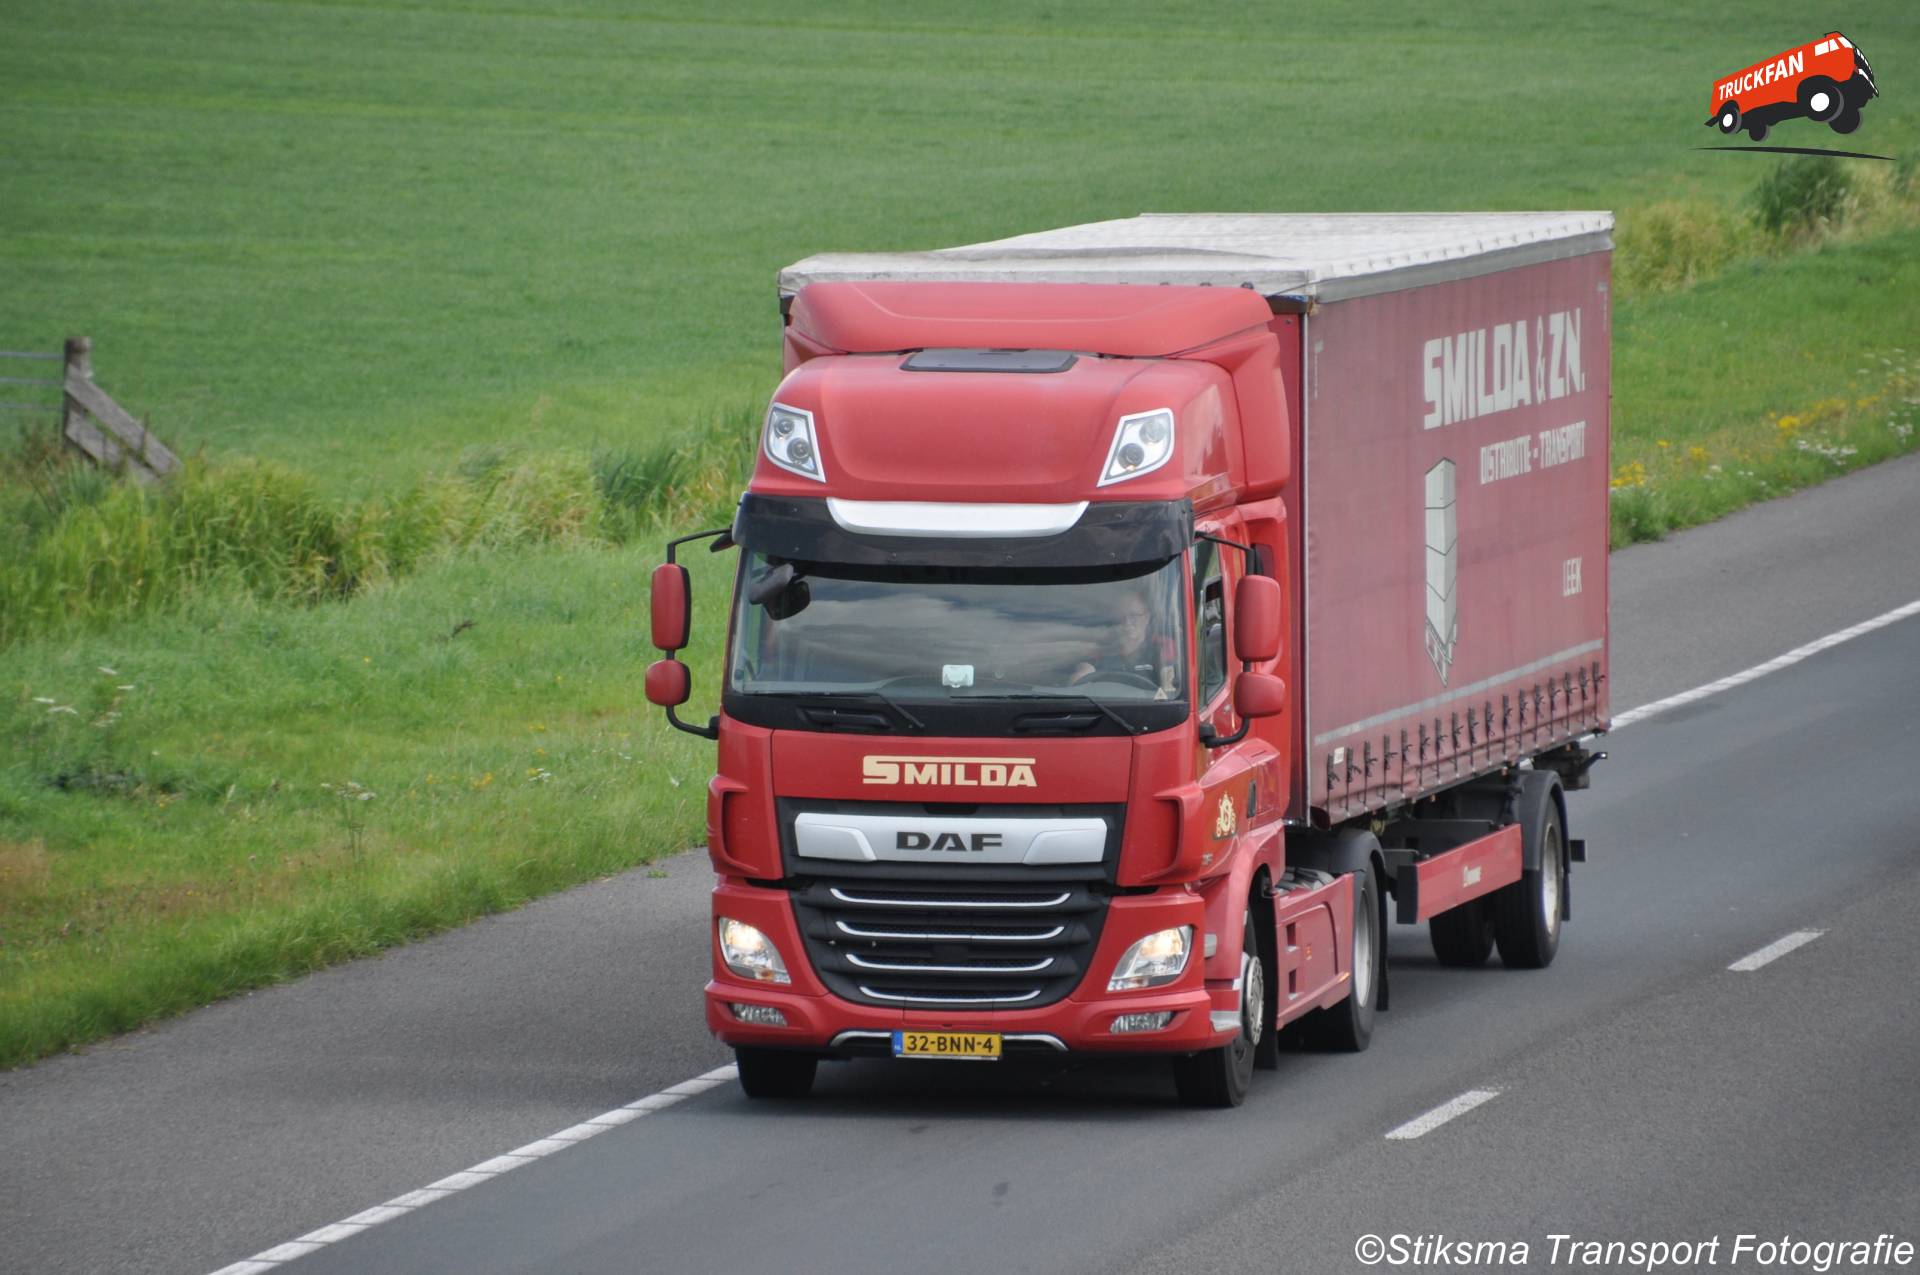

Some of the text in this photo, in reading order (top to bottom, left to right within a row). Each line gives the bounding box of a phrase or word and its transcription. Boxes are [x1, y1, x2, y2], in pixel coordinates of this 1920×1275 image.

[1424, 321, 1531, 430] SMILDA
[1550, 308, 1585, 399] ZN.
[1480, 435, 1531, 484] DISTRIBUTIE
[1539, 421, 1586, 468] TRANSPORT
[1563, 557, 1582, 597] LEEK
[863, 756, 1037, 787] SMILDA
[896, 831, 1002, 852] DAF
[907, 1035, 993, 1053] 32-BNN-4
